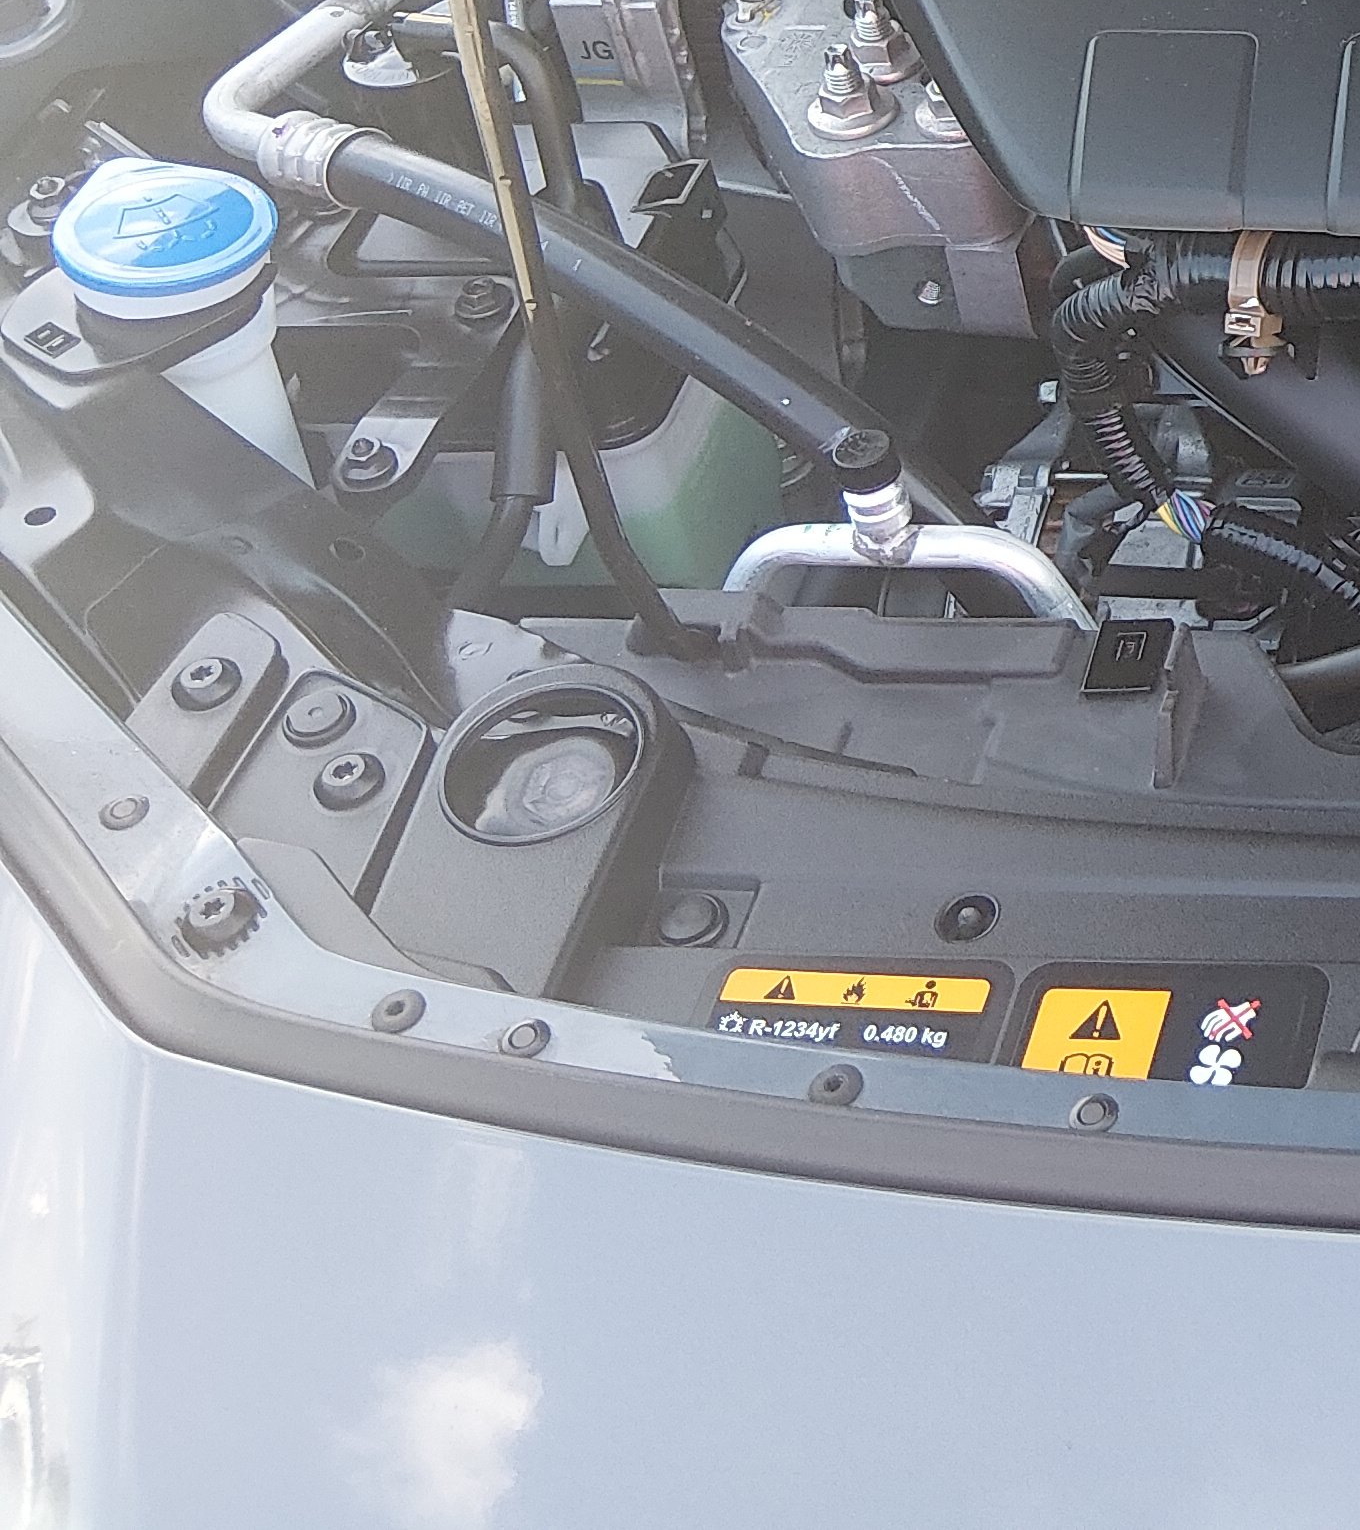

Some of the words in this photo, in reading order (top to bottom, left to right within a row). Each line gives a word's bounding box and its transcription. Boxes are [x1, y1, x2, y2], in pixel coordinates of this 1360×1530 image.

[581, 40, 614, 59] JG
[748, 1017, 839, 1042] R-1234yf
[863, 1023, 916, 1044] 0.480
[921, 1028, 947, 1048] kg
